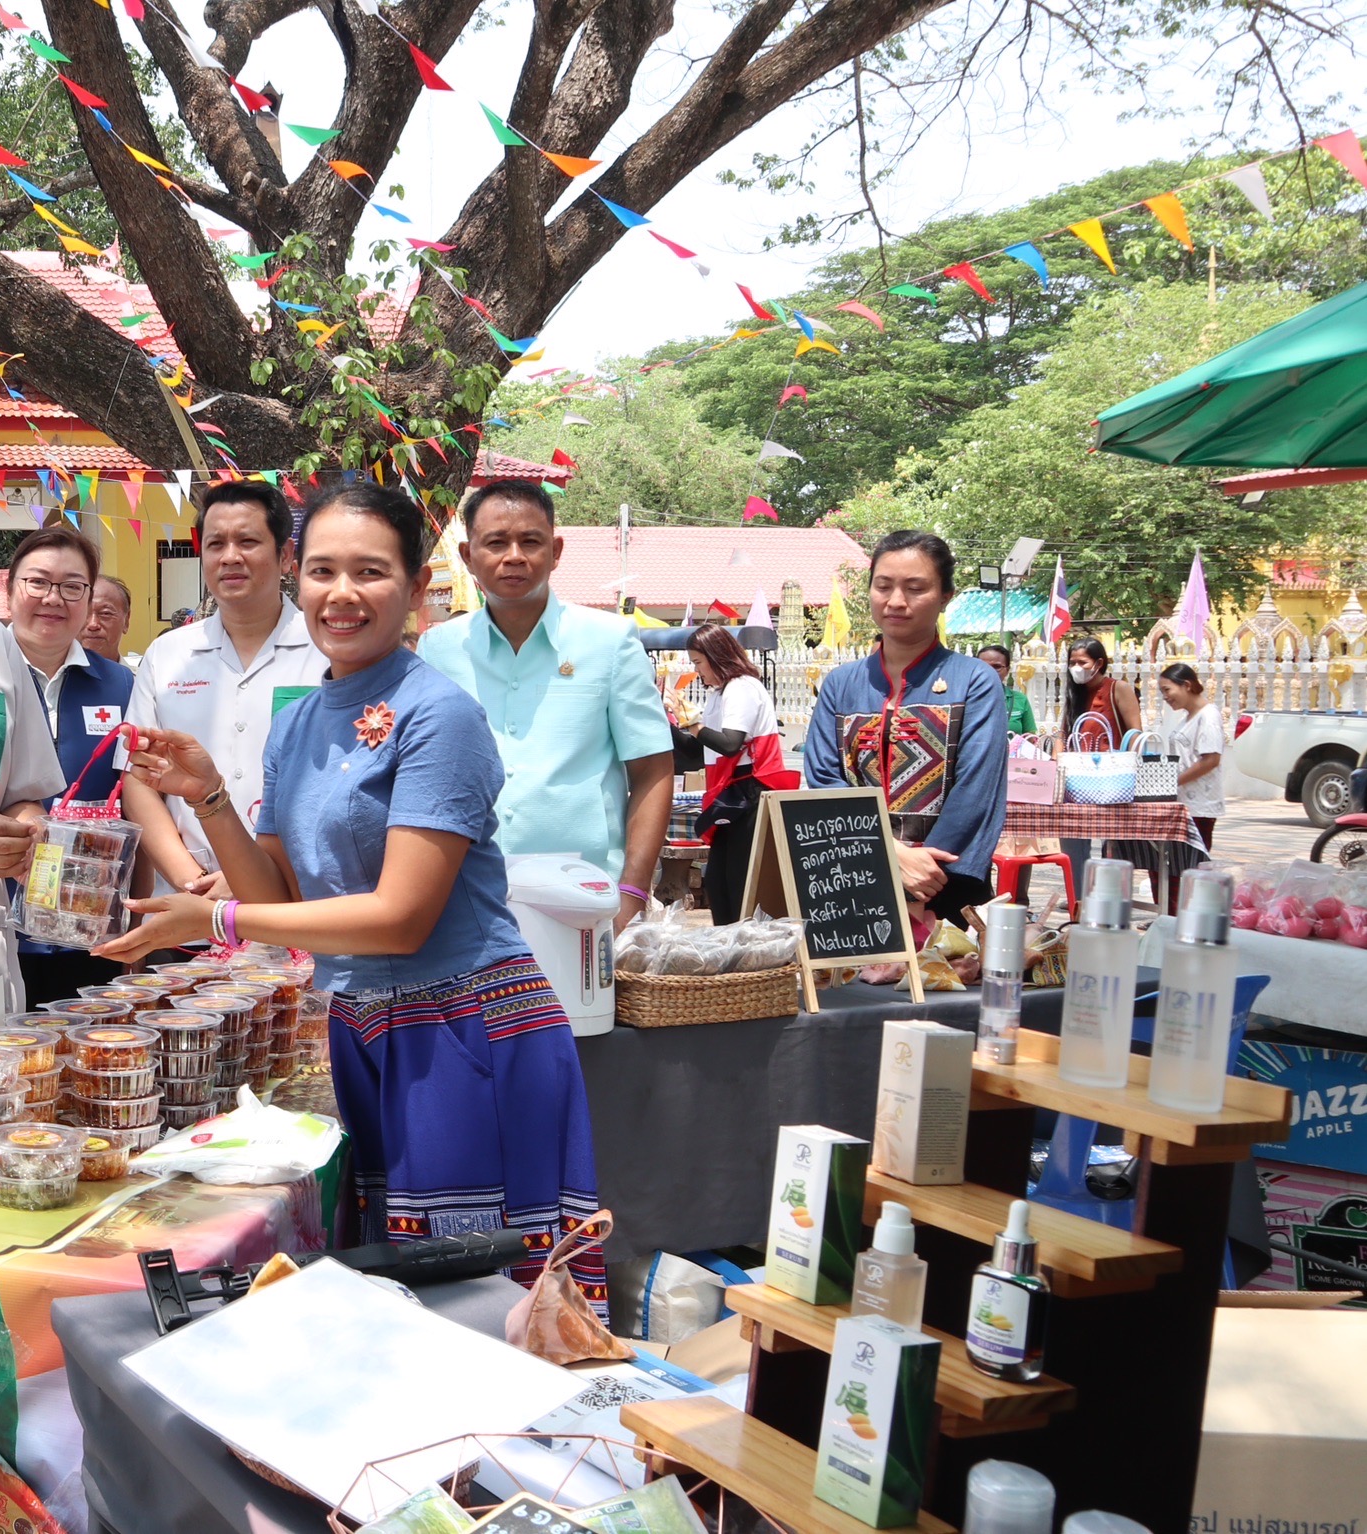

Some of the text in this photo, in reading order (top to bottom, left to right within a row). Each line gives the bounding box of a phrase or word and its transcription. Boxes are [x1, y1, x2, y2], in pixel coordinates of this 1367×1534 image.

[799, 840, 873, 871] ลดความมัน
[808, 898, 888, 924] Kaffir Lime
[812, 923, 874, 952] Natural
[1290, 1083, 1367, 1127] JAZZ
[1306, 1120, 1353, 1139] APPLE
[1307, 1274, 1365, 1288] HOME GROWN
[976, 1338, 1004, 1353] SERUM
[605, 1503, 630, 1515] GEL
